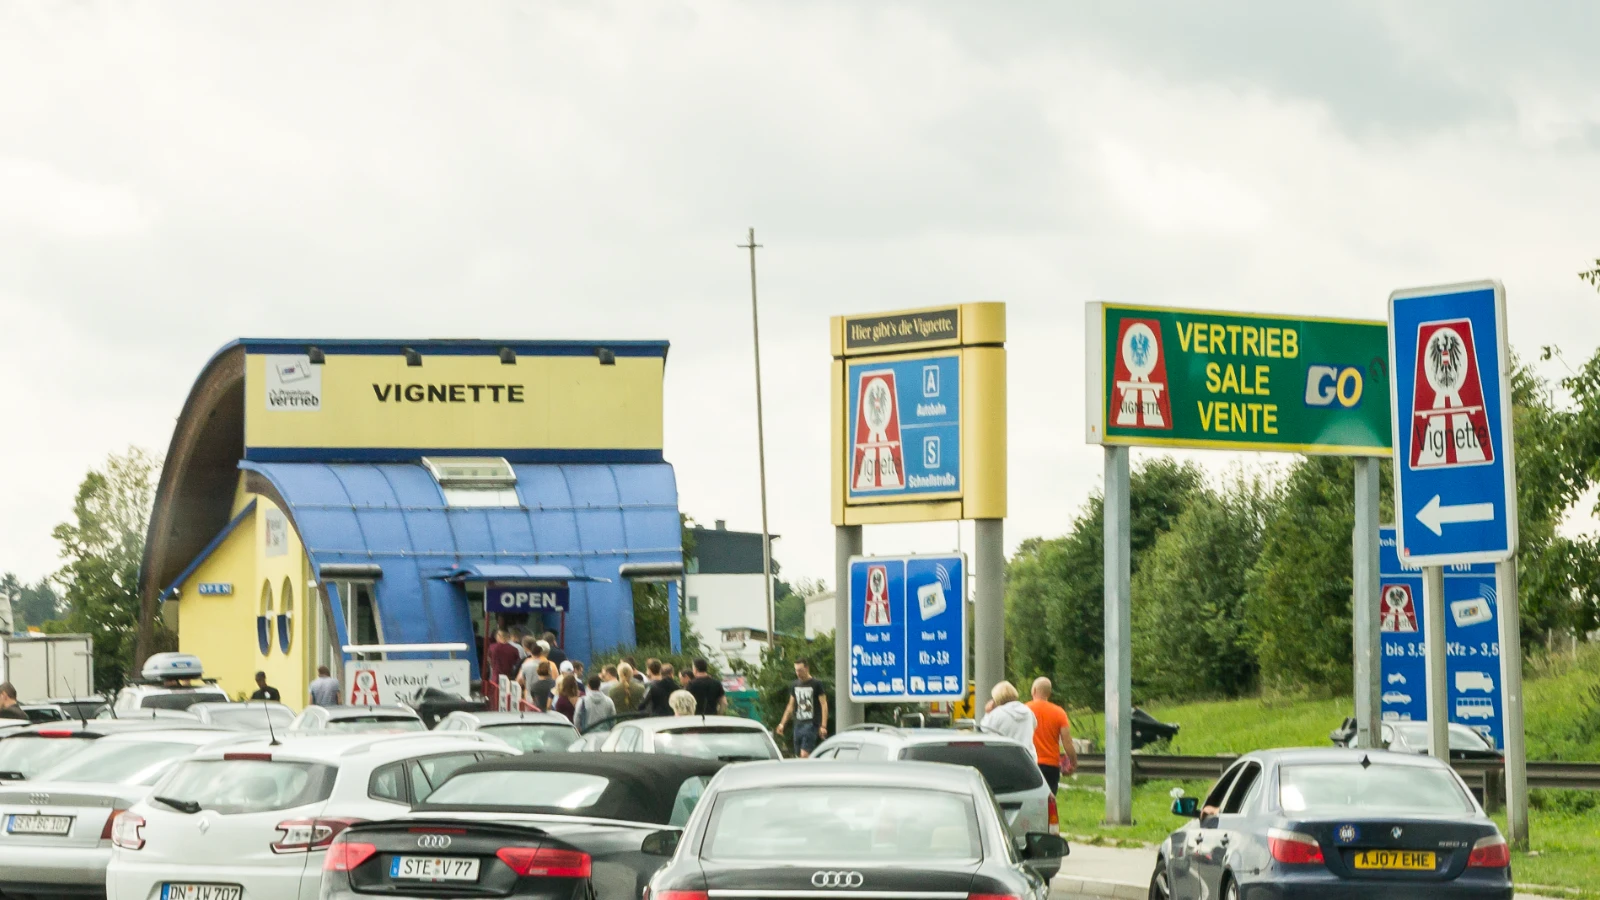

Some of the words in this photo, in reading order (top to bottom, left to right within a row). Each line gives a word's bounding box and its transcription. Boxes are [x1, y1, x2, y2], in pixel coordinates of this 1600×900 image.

[851, 324, 872, 340] Hier
[899, 319, 913, 336] die
[1176, 320, 1299, 359] VERTRIEB
[926, 370, 936, 393] A
[1205, 362, 1270, 395] SALE
[1305, 365, 1363, 407] GO
[372, 383, 525, 403] VIGNETTE
[916, 402, 946, 417] Autobahn
[1197, 401, 1278, 434] VENTE
[1415, 421, 1487, 458] Vignette
[927, 441, 937, 464] S
[199, 584, 230, 593] OPEN
[500, 592, 557, 609] OPEN
[1385, 642, 1404, 657] bis
[1446, 642, 1466, 657] Kfz
[384, 673, 429, 686] Verkauf
[404, 858, 432, 875] STE
[442, 859, 452, 875] V
[455, 861, 473, 876] 77
[1361, 851, 1401, 866] AJ07
[1402, 853, 1430, 867] EHE
[170, 885, 186, 899] DN
[214, 887, 238, 900] 707
